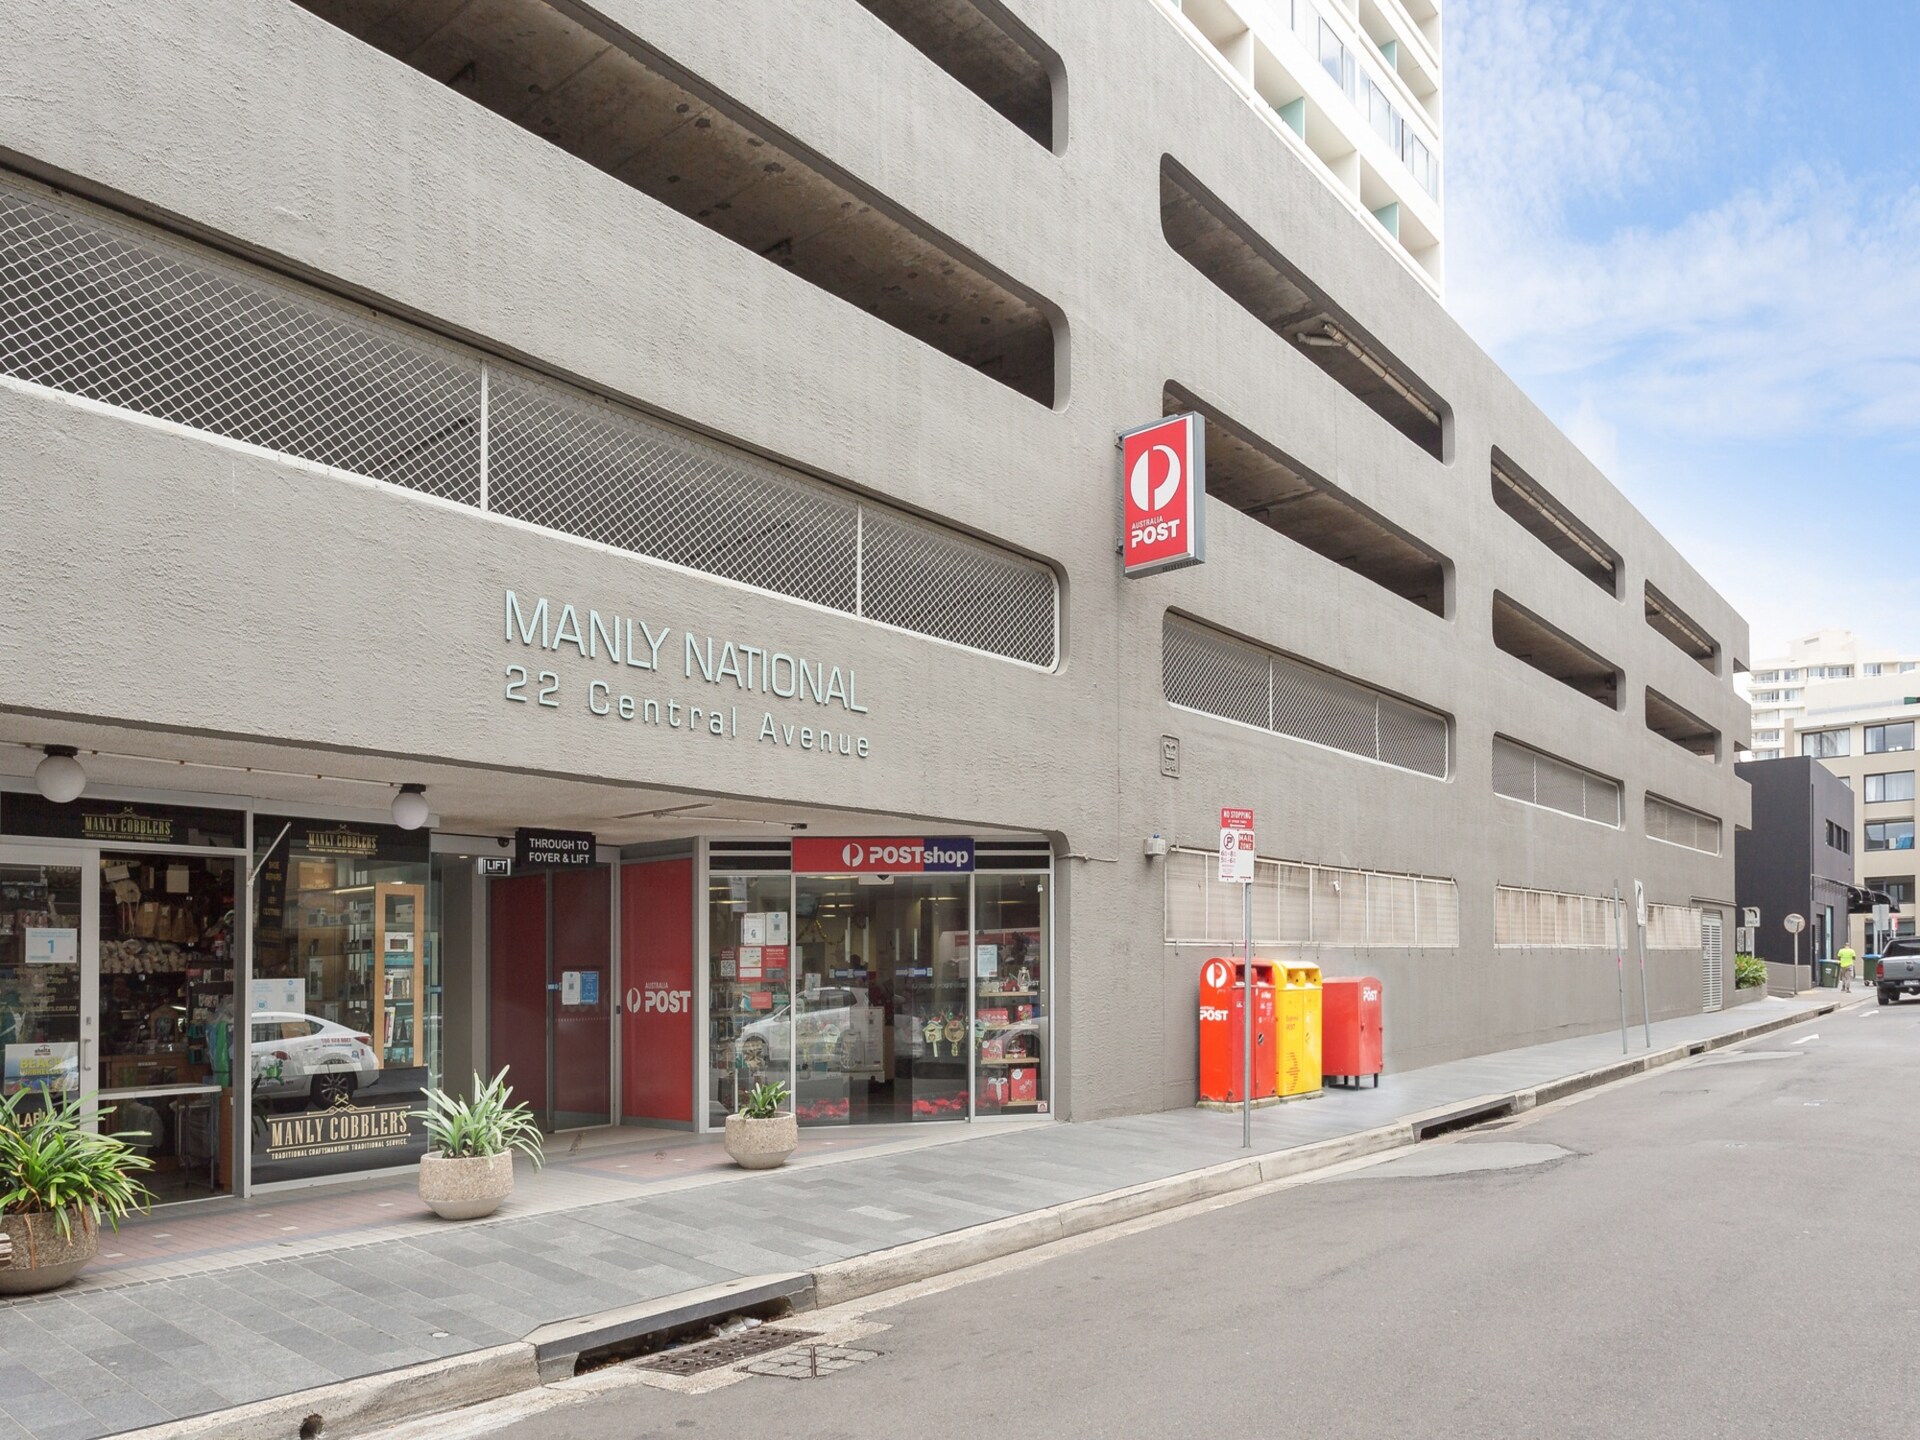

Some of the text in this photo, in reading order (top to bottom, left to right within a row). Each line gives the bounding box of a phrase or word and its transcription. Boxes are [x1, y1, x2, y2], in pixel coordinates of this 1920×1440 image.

[1131, 516, 1163, 530] AUSTRALIA
[1131, 519, 1180, 549] POST
[505, 589, 868, 714] MANLY NATIONAL
[505, 664, 869, 758] 22 Central Avenue
[85, 816, 171, 835] MANLY COBBLERS
[308, 832, 334, 847] MANLY
[529, 838, 589, 851] THROUGH TO
[1239, 834, 1253, 842] MAIL
[1239, 842, 1252, 850] ZONE
[529, 852, 590, 864] FOYER & LIFT
[487, 860, 506, 871] LIFT
[644, 990, 691, 1013] POST
[1362, 989, 1378, 1001] POST
[1200, 1010, 1228, 1021] POST
[271, 1110, 408, 1147] MANLY COBBLERS
[271, 1149, 307, 1160] TRADITIONAL
[308, 1145, 350, 1156] CRAFTSMANSHIP
[351, 1141, 385, 1151] TRADITIONAL
